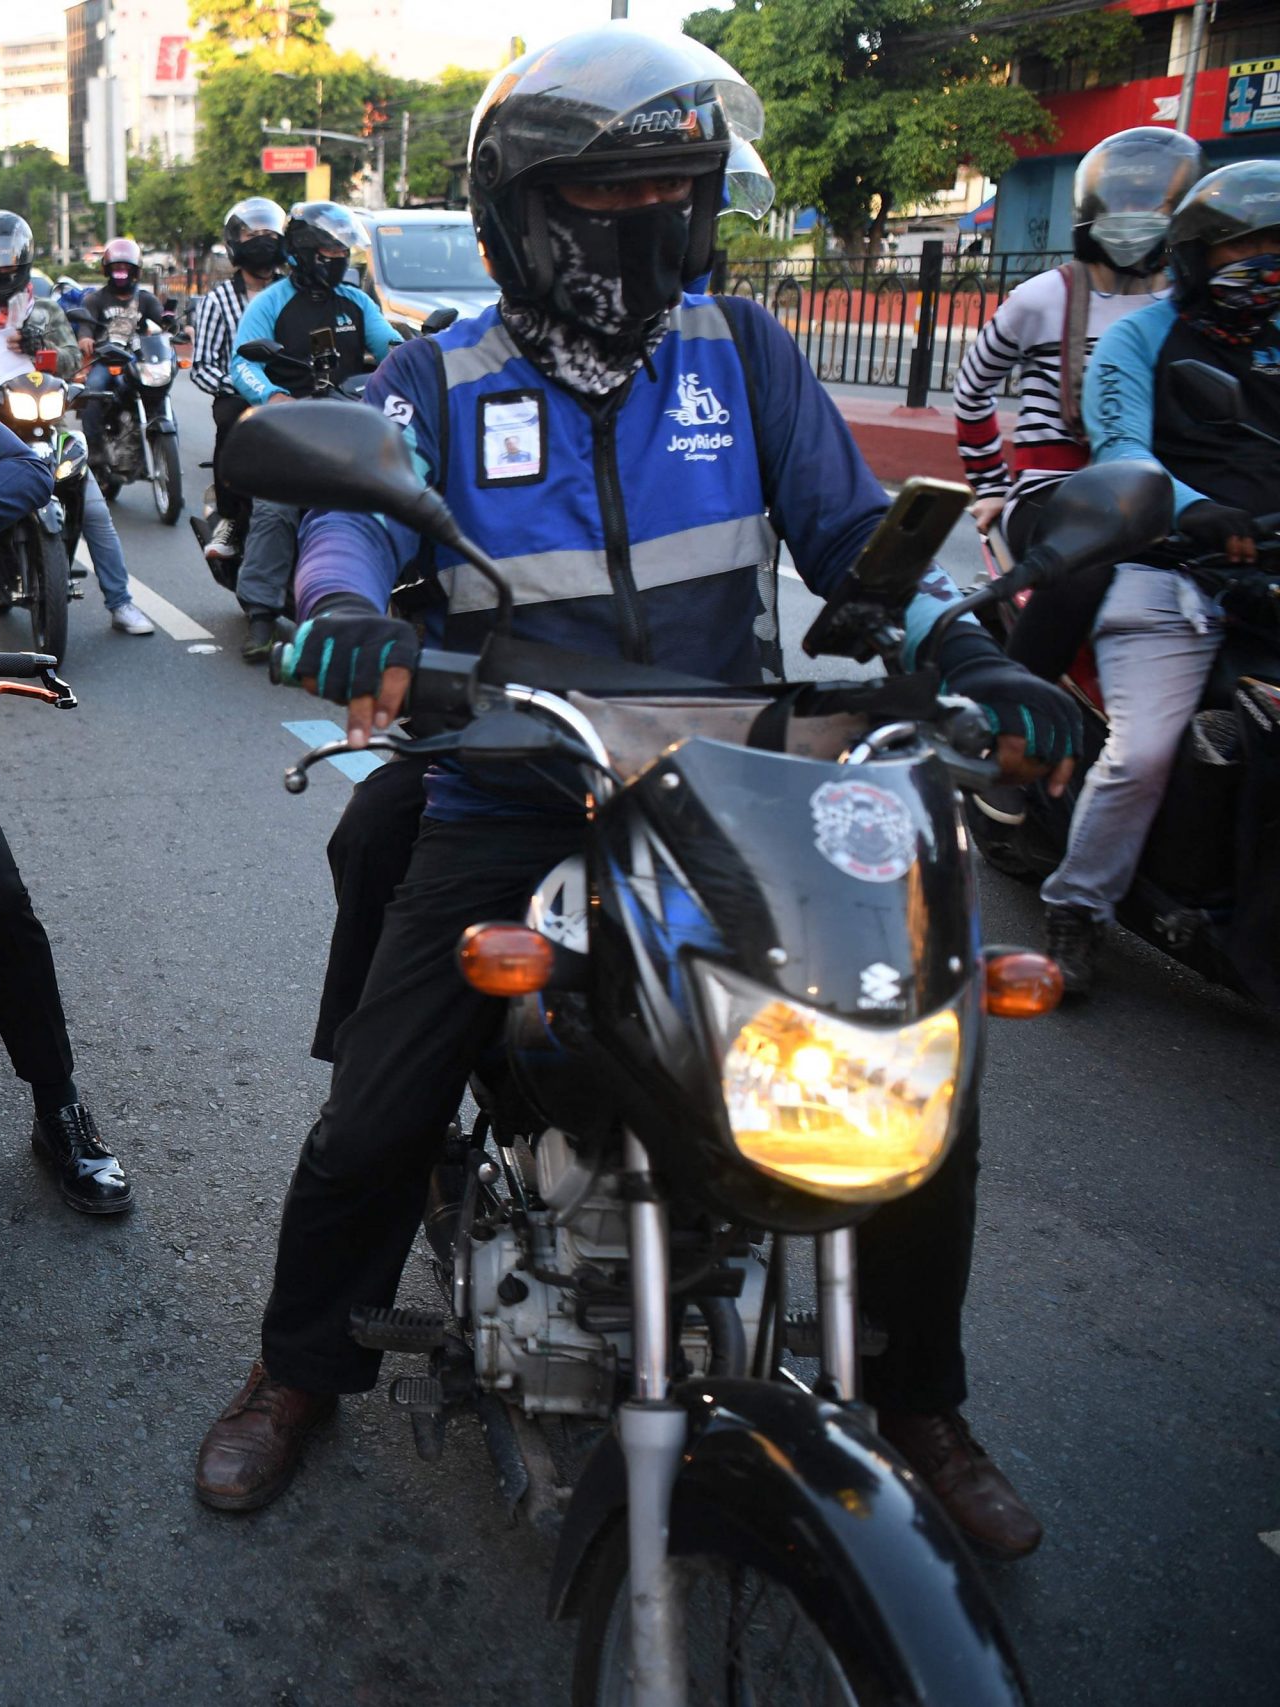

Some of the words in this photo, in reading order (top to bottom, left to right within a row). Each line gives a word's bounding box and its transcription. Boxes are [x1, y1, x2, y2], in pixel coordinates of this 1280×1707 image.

[1236, 61, 1275, 75] LTO
[1262, 72, 1280, 94] D
[631, 109, 697, 135] HNJ
[666, 433, 734, 452] JoyRide
